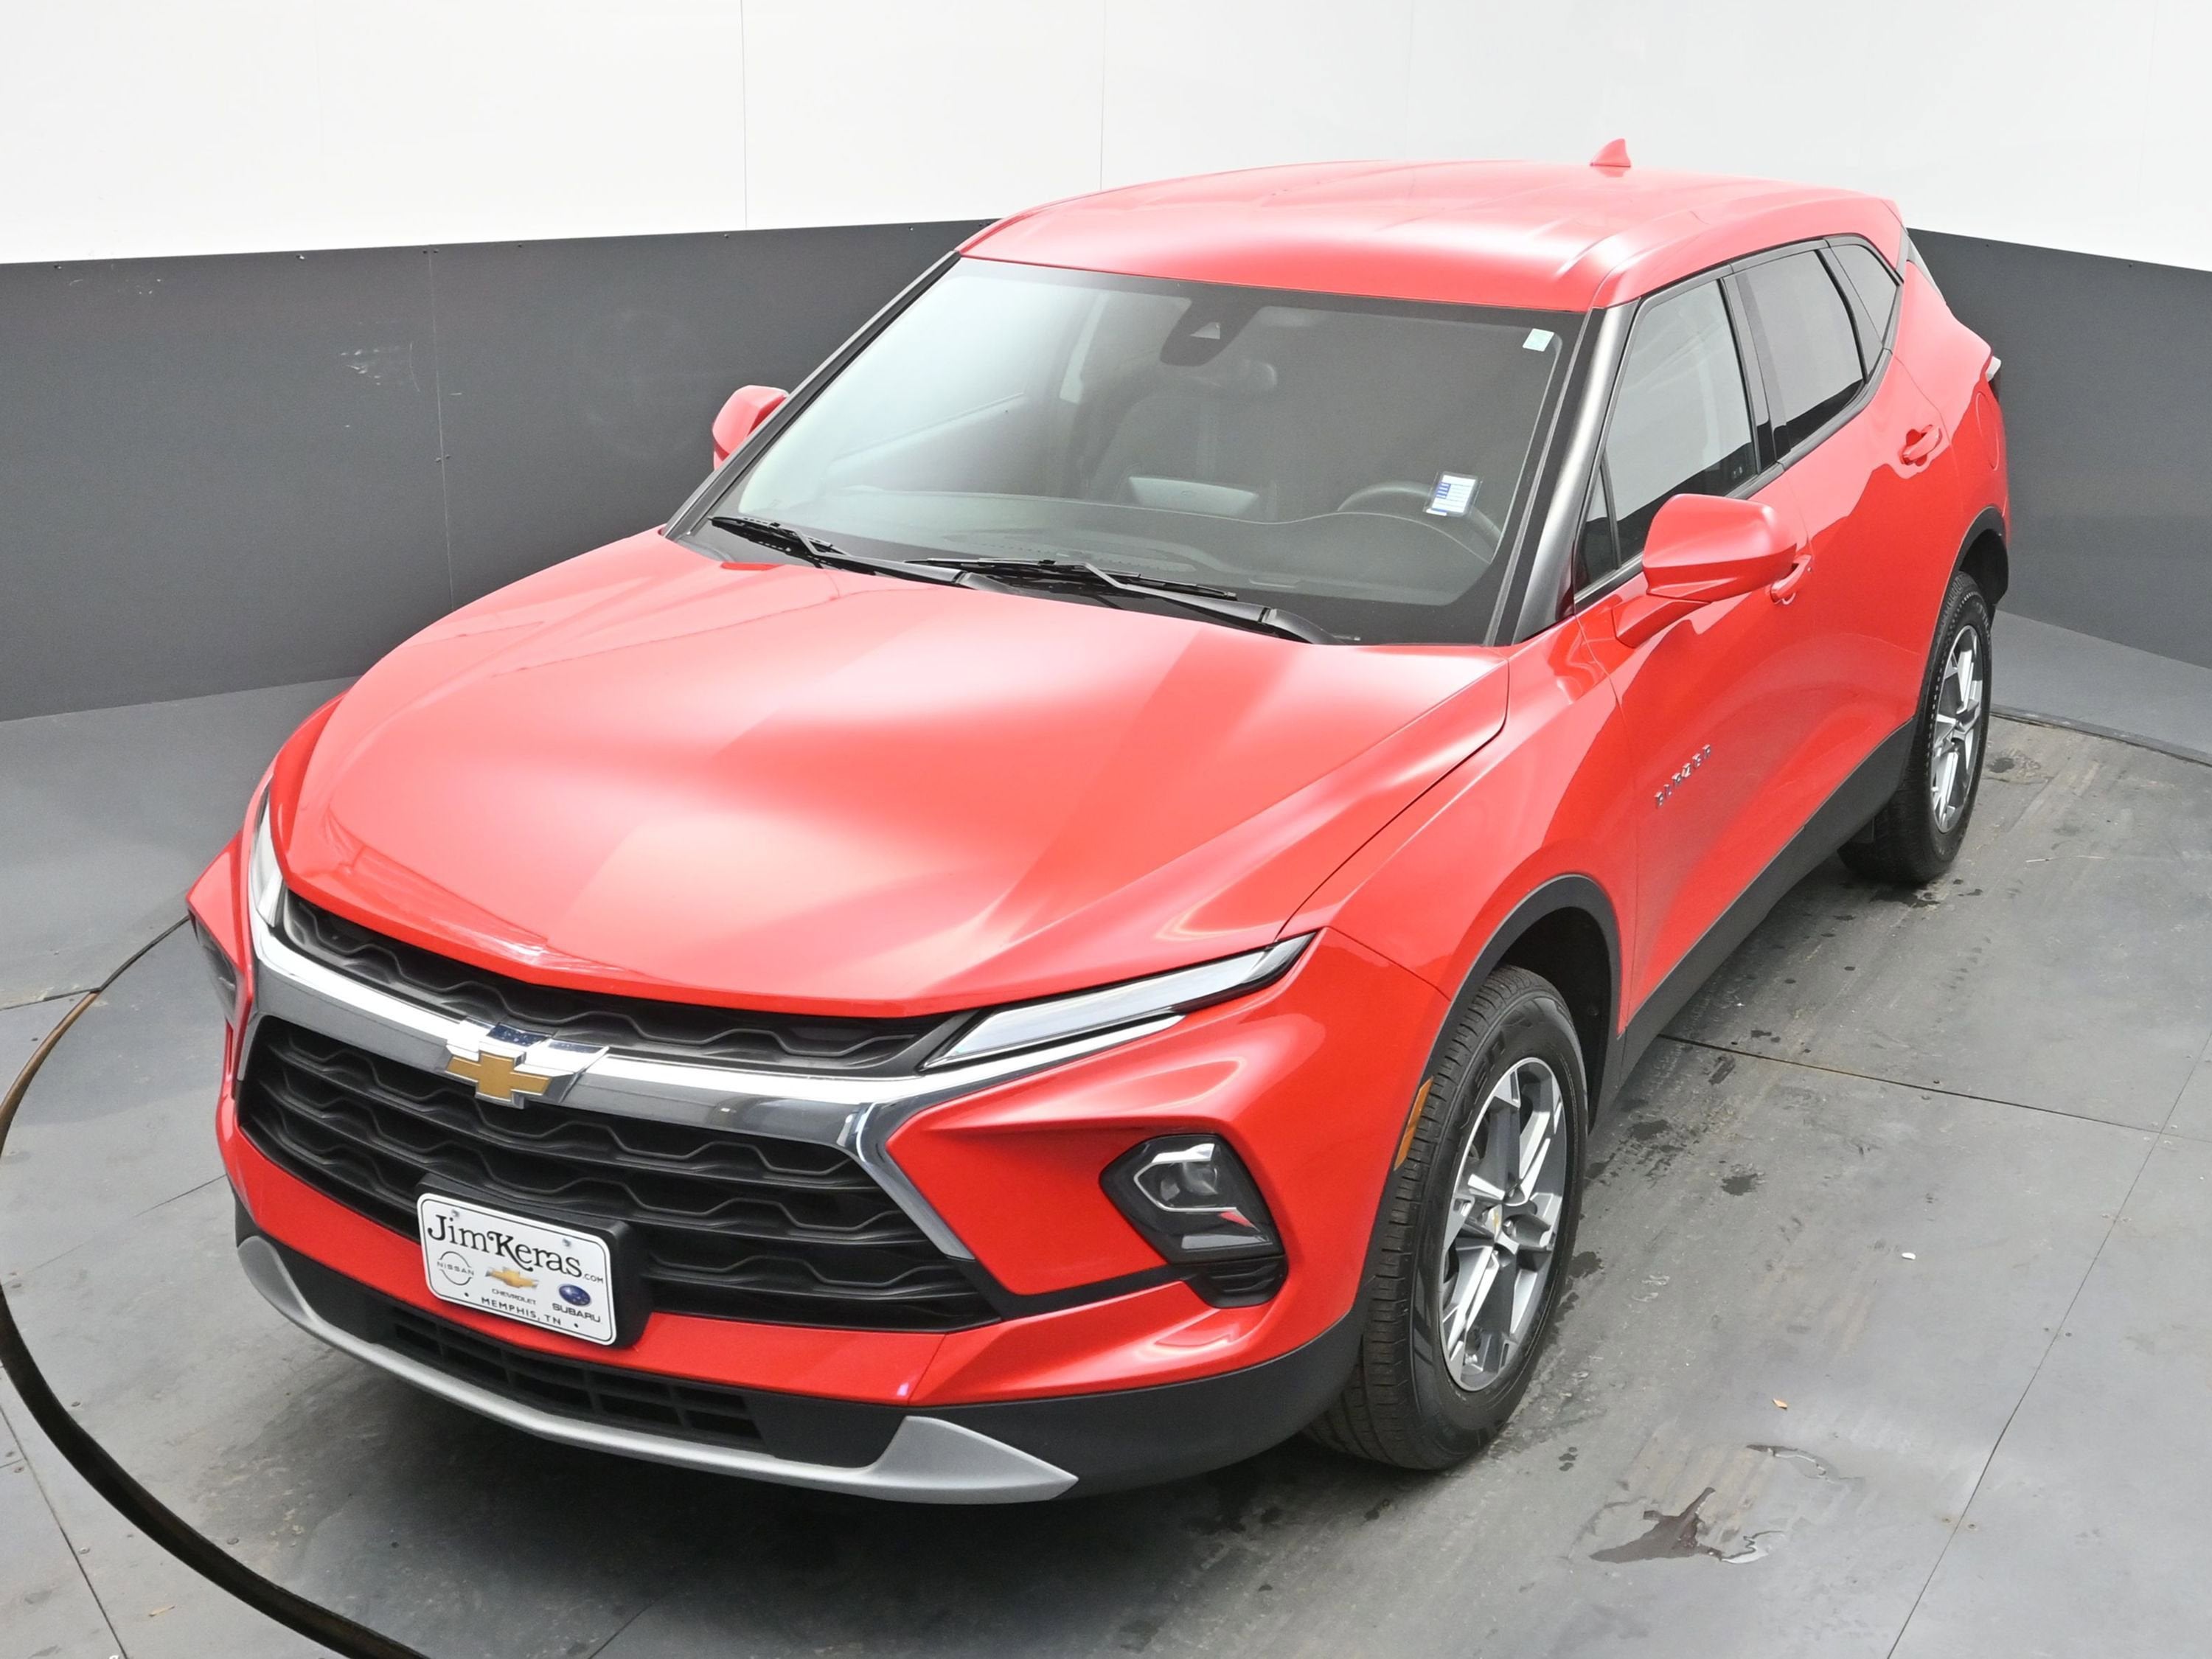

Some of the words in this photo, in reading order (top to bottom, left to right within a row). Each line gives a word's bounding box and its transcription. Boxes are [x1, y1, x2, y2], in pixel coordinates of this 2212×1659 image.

[437, 1261, 474, 1276] NISSAN
[492, 1288, 536, 1305] CHEVROLET
[481, 1296, 540, 1321] MEMPHIS,
[544, 1314, 561, 1326] TN
[552, 1303, 601, 1323] SUBARU
